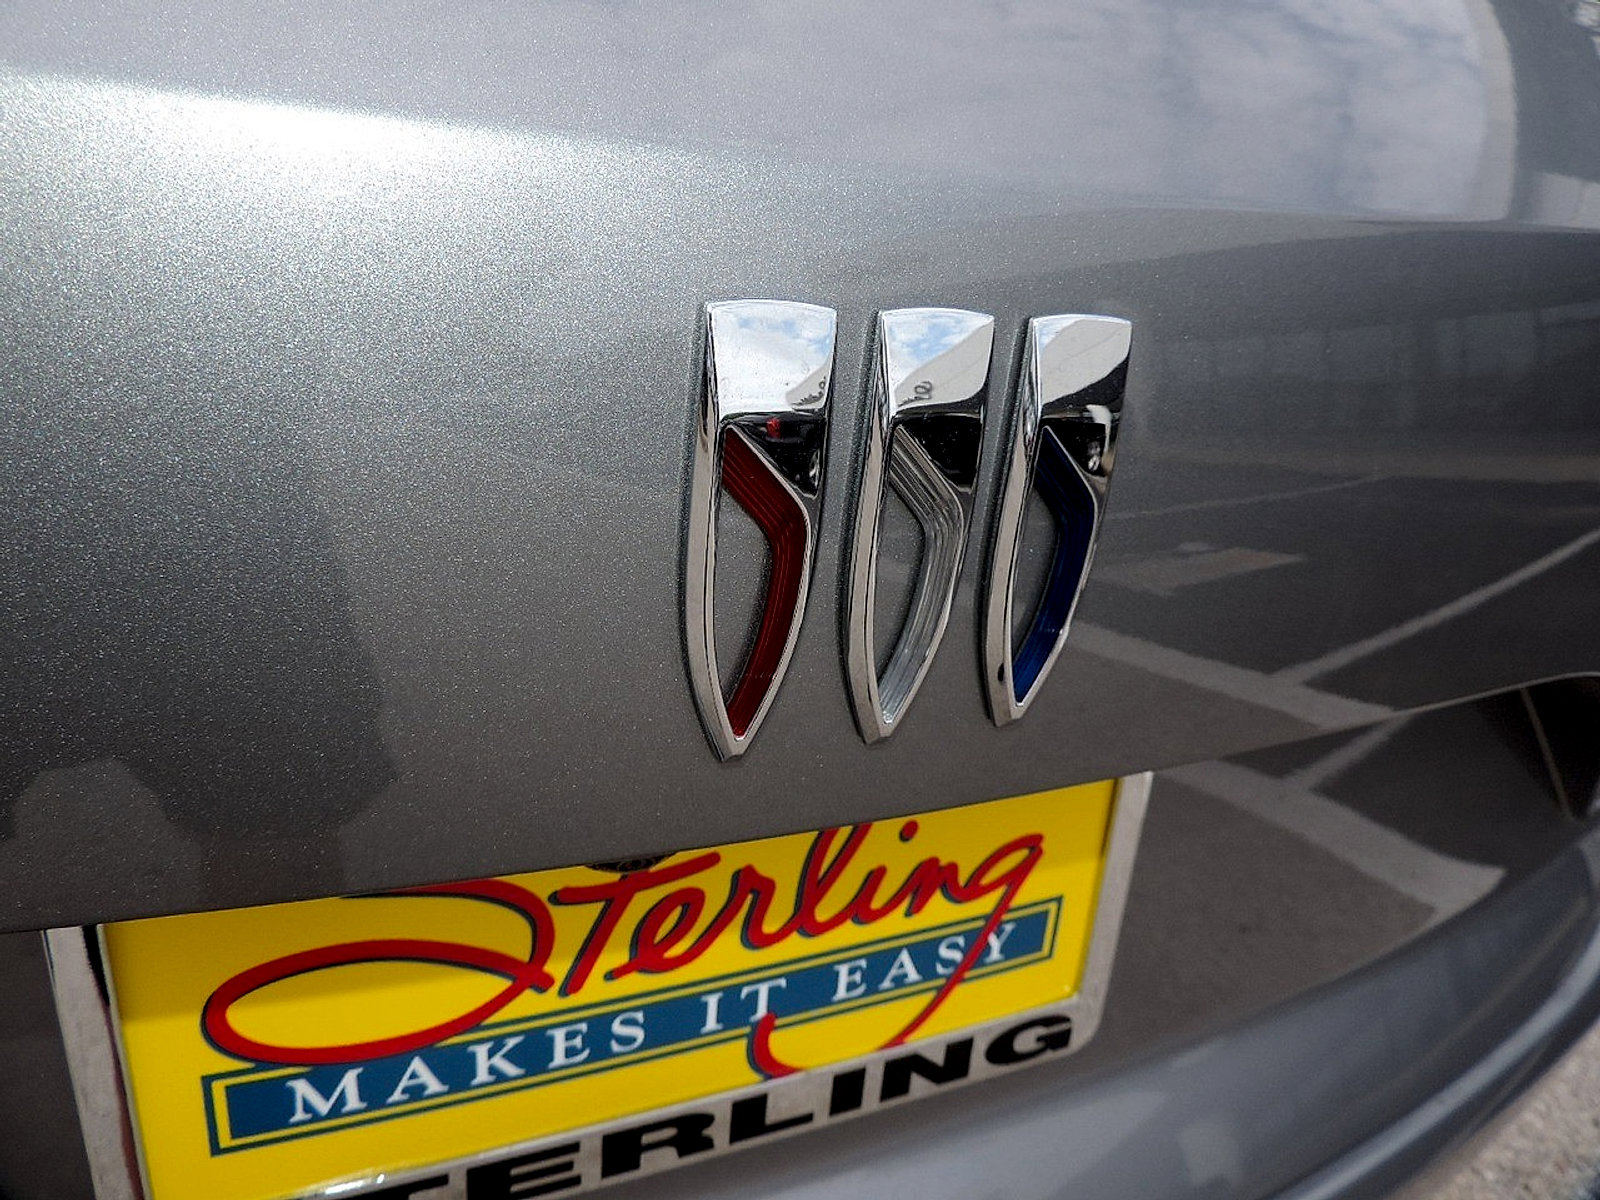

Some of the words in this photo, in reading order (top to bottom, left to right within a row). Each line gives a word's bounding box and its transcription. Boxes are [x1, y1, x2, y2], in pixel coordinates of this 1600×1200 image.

[200, 821, 1045, 1079] Sterling
[287, 1008, 646, 1124] MAKES
[698, 976, 787, 1036] IT
[831, 923, 1016, 1002] EASY
